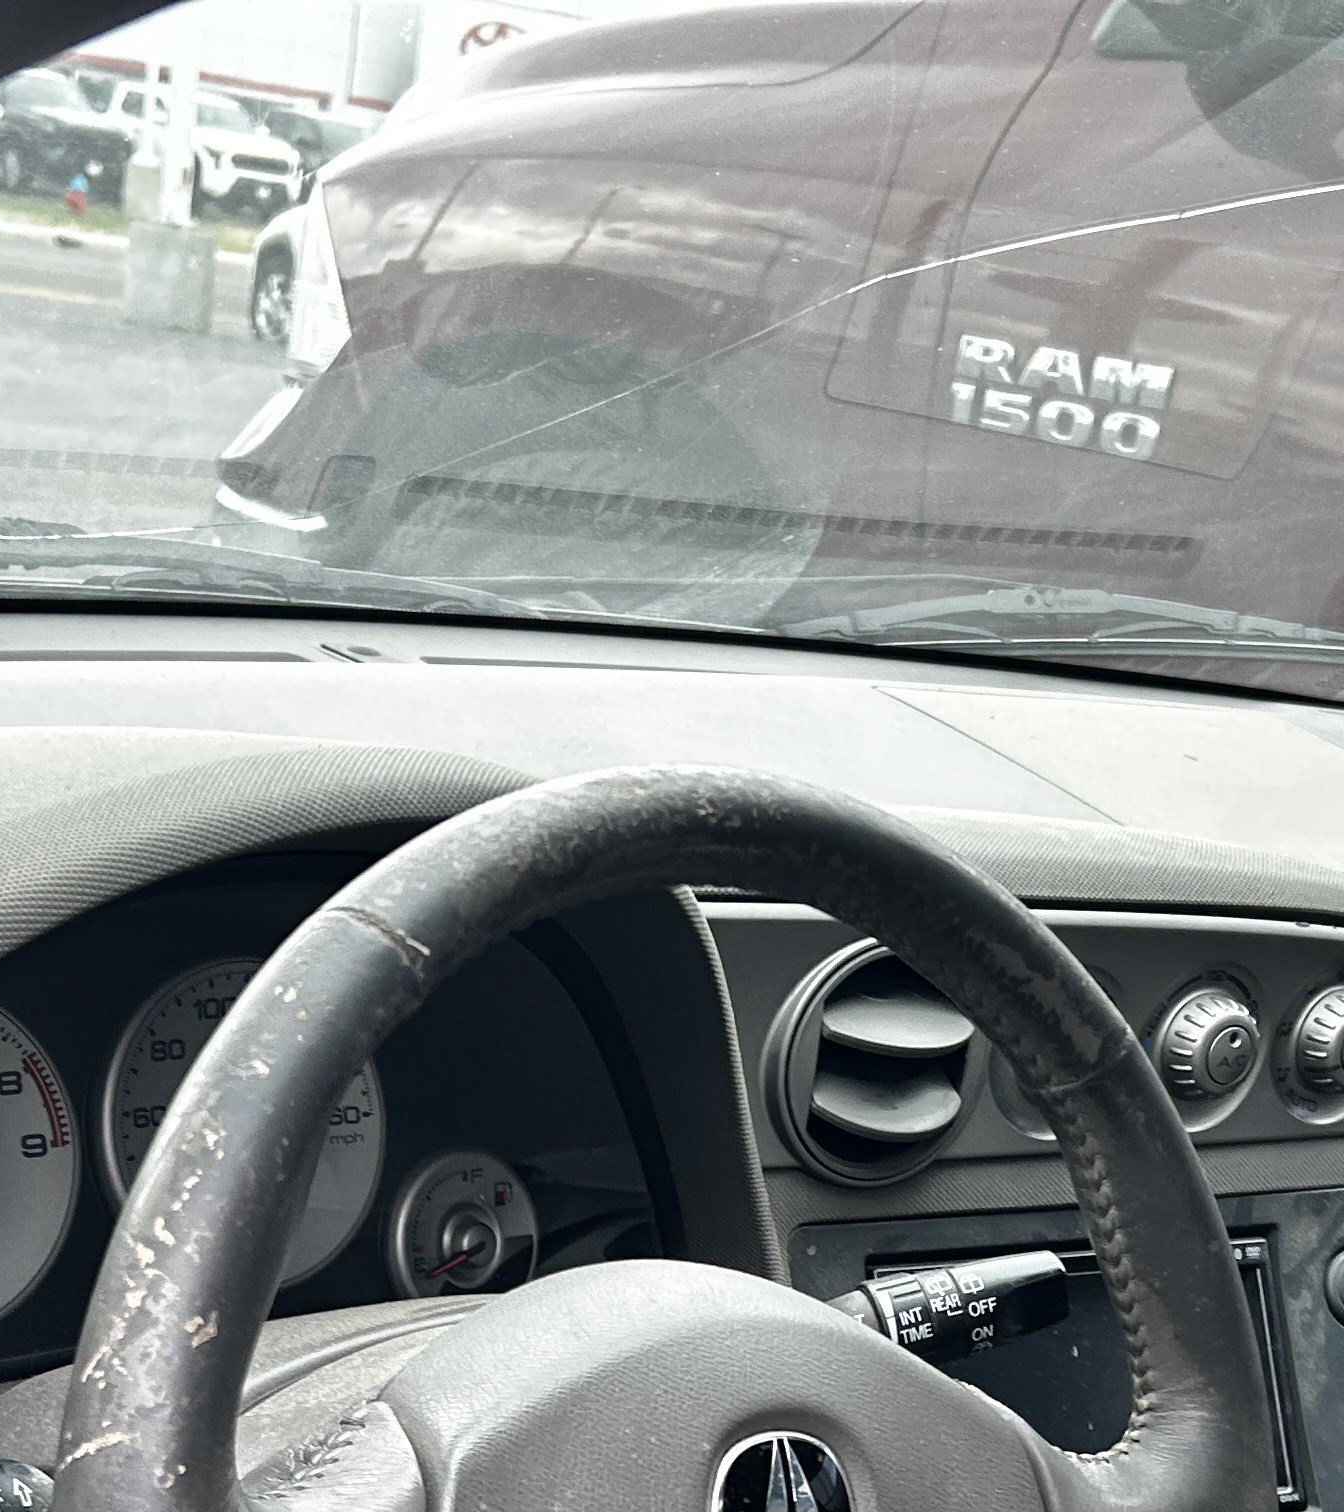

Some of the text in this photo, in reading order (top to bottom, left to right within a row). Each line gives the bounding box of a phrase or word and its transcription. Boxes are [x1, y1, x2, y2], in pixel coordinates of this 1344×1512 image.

[957, 334, 1175, 409] RAM
[950, 382, 1161, 461] 1500
[150, 1039, 186, 1062] 80
[22, 1133, 47, 1158] 9
[930, 1293, 962, 1313] REAR
[968, 1296, 998, 1318] OFF
[898, 1306, 923, 1327] INT
[899, 1323, 934, 1345] TIME
[971, 1325, 995, 1342] ON
